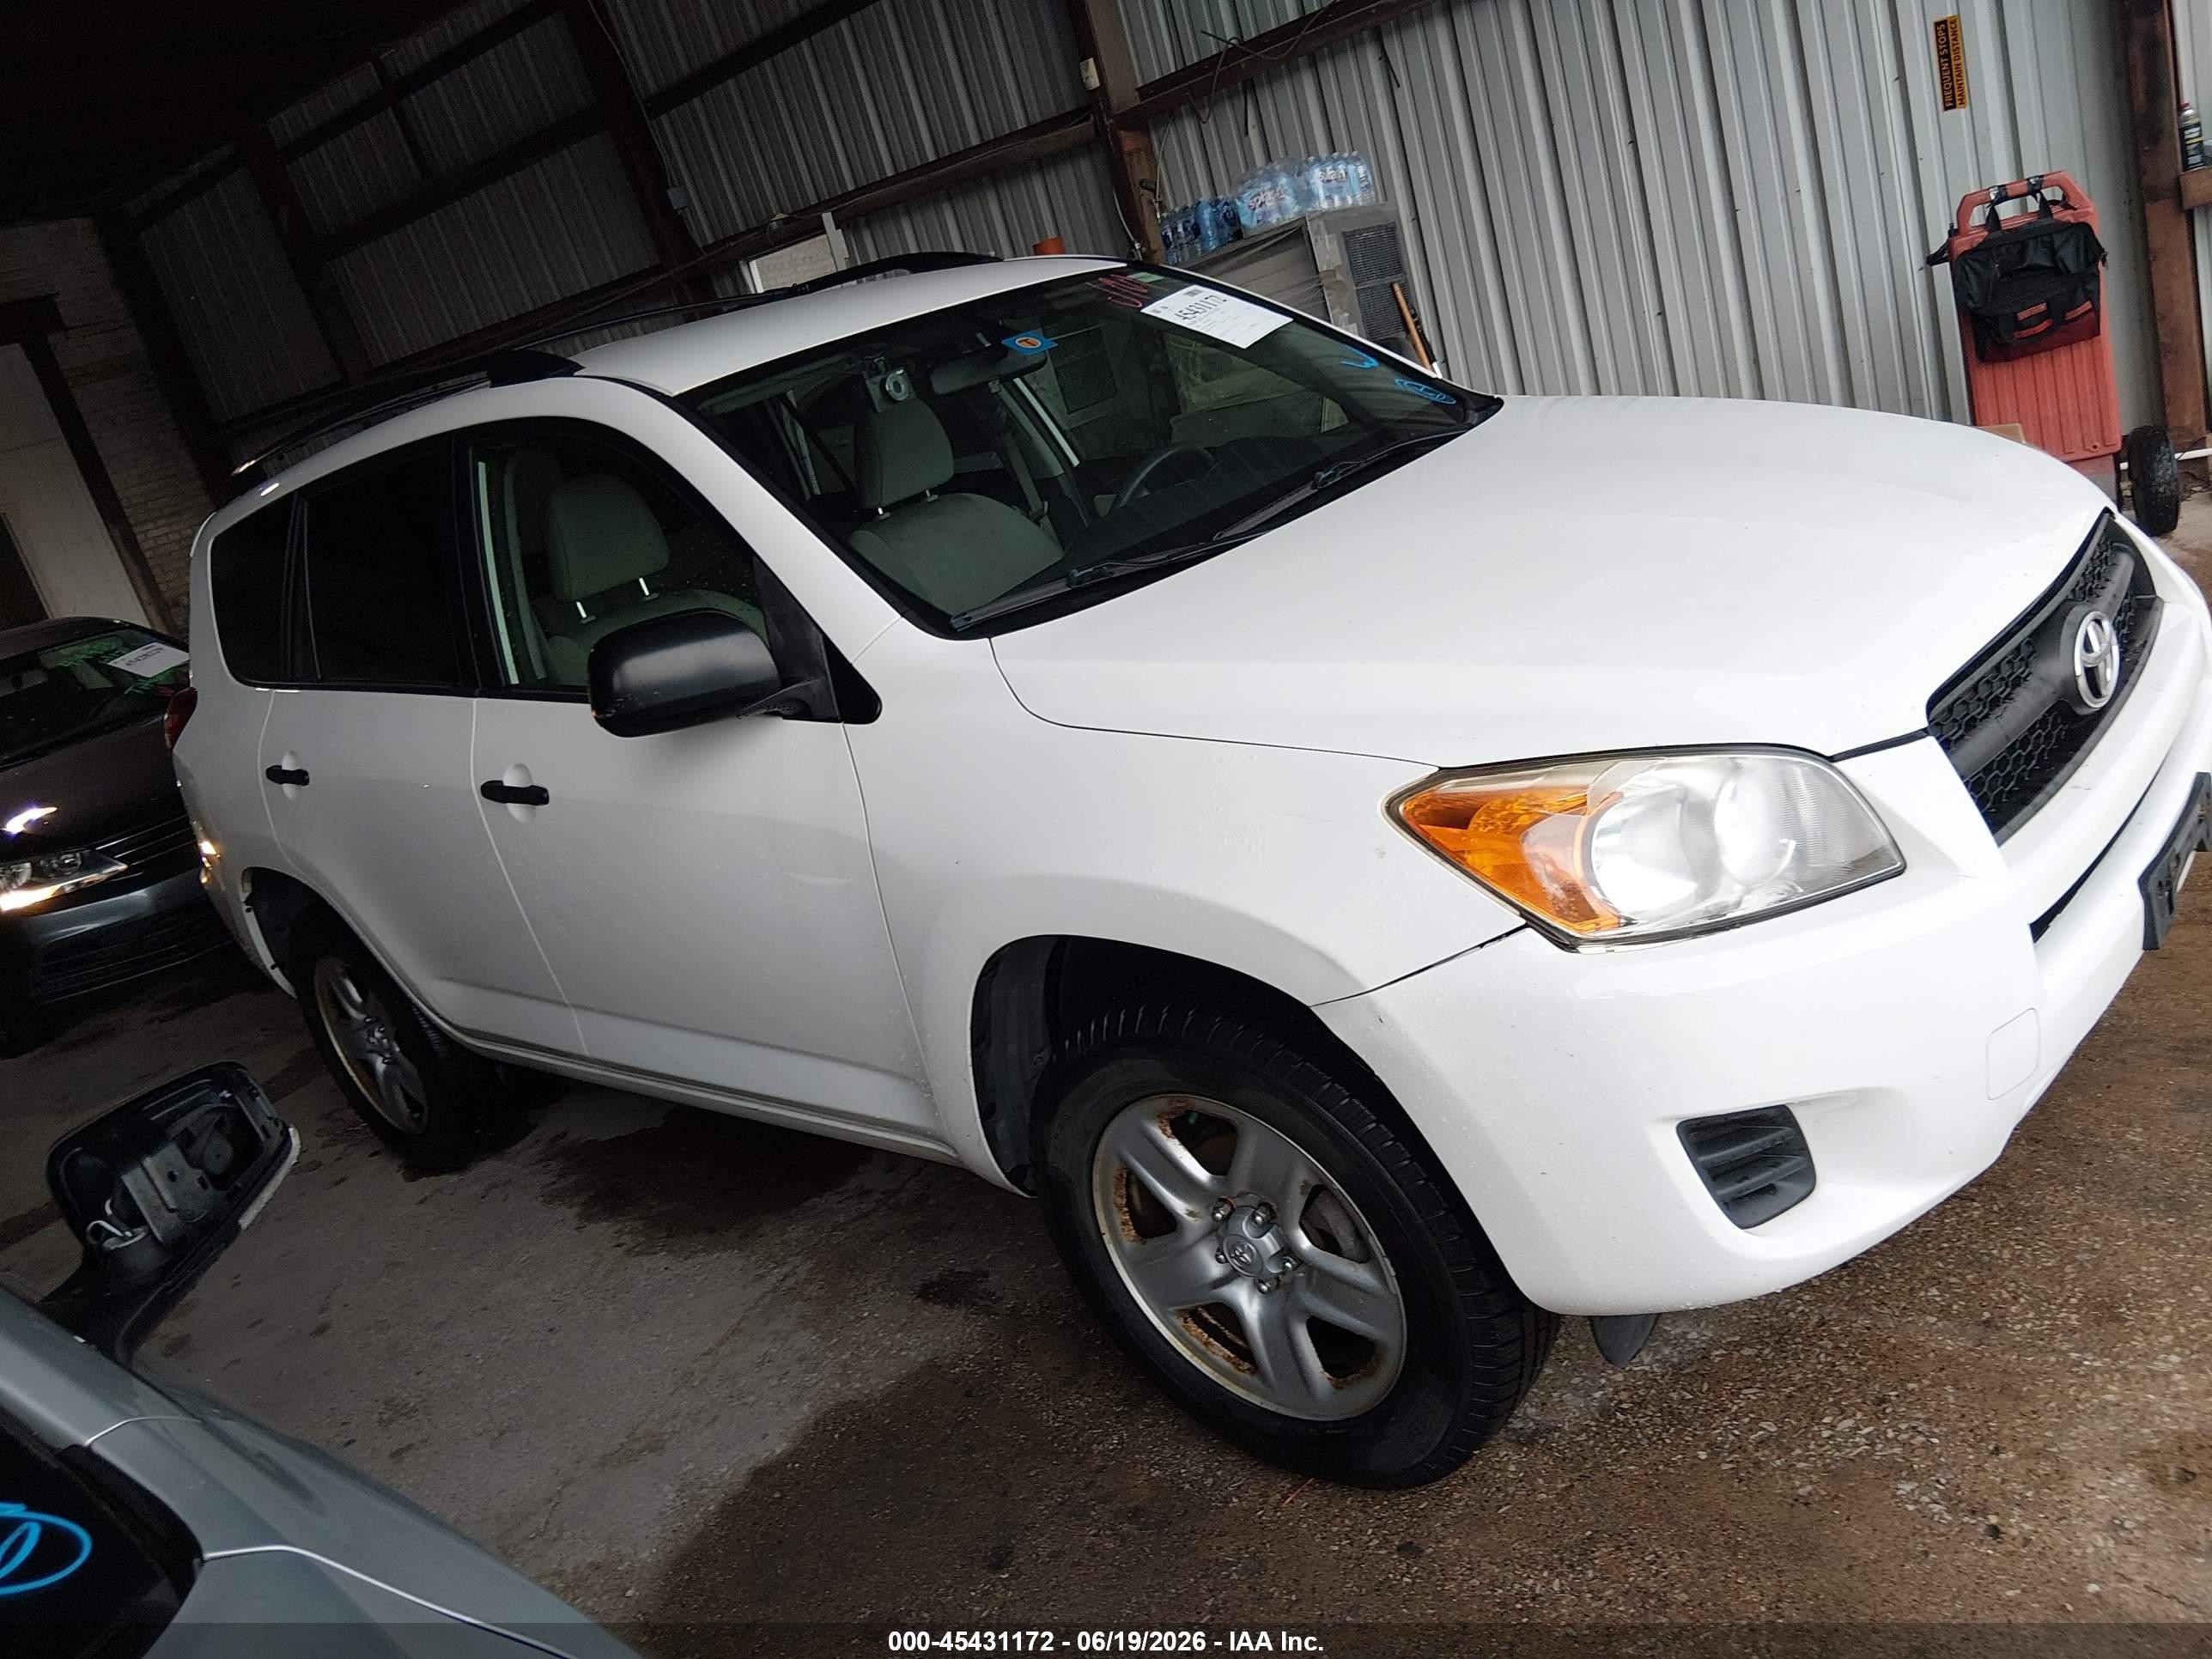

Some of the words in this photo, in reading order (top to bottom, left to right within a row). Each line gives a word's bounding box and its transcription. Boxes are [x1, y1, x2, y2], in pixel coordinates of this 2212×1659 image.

[1937, 23, 1948, 56] STOPS
[1949, 20, 1962, 62] DISTANCE
[1941, 58, 1954, 107] FREQUENT
[1954, 63, 1966, 106] MAINTAIN
